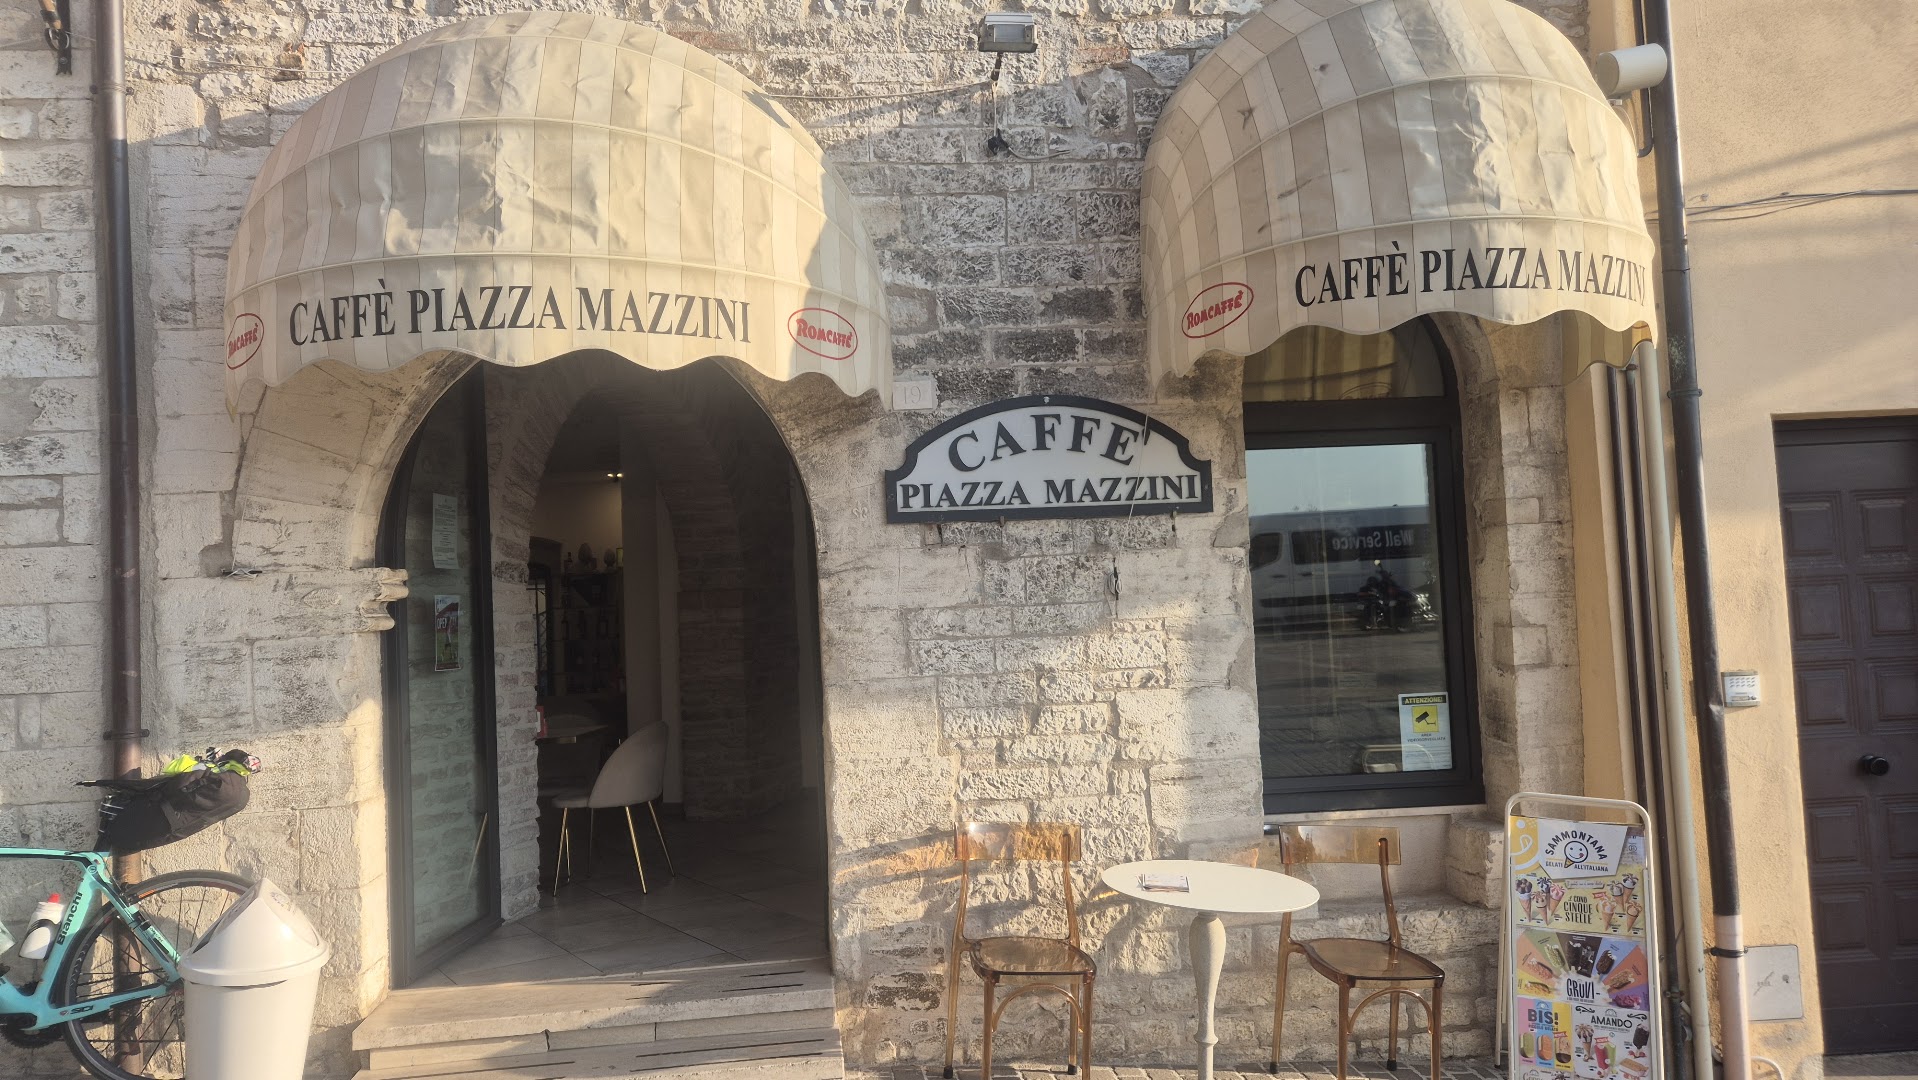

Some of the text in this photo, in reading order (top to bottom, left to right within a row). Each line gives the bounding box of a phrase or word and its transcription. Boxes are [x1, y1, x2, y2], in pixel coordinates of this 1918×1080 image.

[1295, 241, 1646, 307] CAFFÈ PIAZZA MAZZINI
[289, 278, 752, 346] CAFFÈ PIAZZA MAZZINI
[904, 386, 921, 404] 19
[900, 474, 1199, 509] PIAZZA MAZZINI
[1404, 696, 1443, 705] ATTENZIONE!
[1545, 830, 1608, 860] SAMMONTANA
[1563, 901, 1592, 914] CINQUE
[56, 891, 83, 945] Bianchi
[1565, 913, 1593, 924] STELLE
[1527, 1008, 1559, 1026] BIS!
[1590, 1015, 1633, 1028] AMANDO
